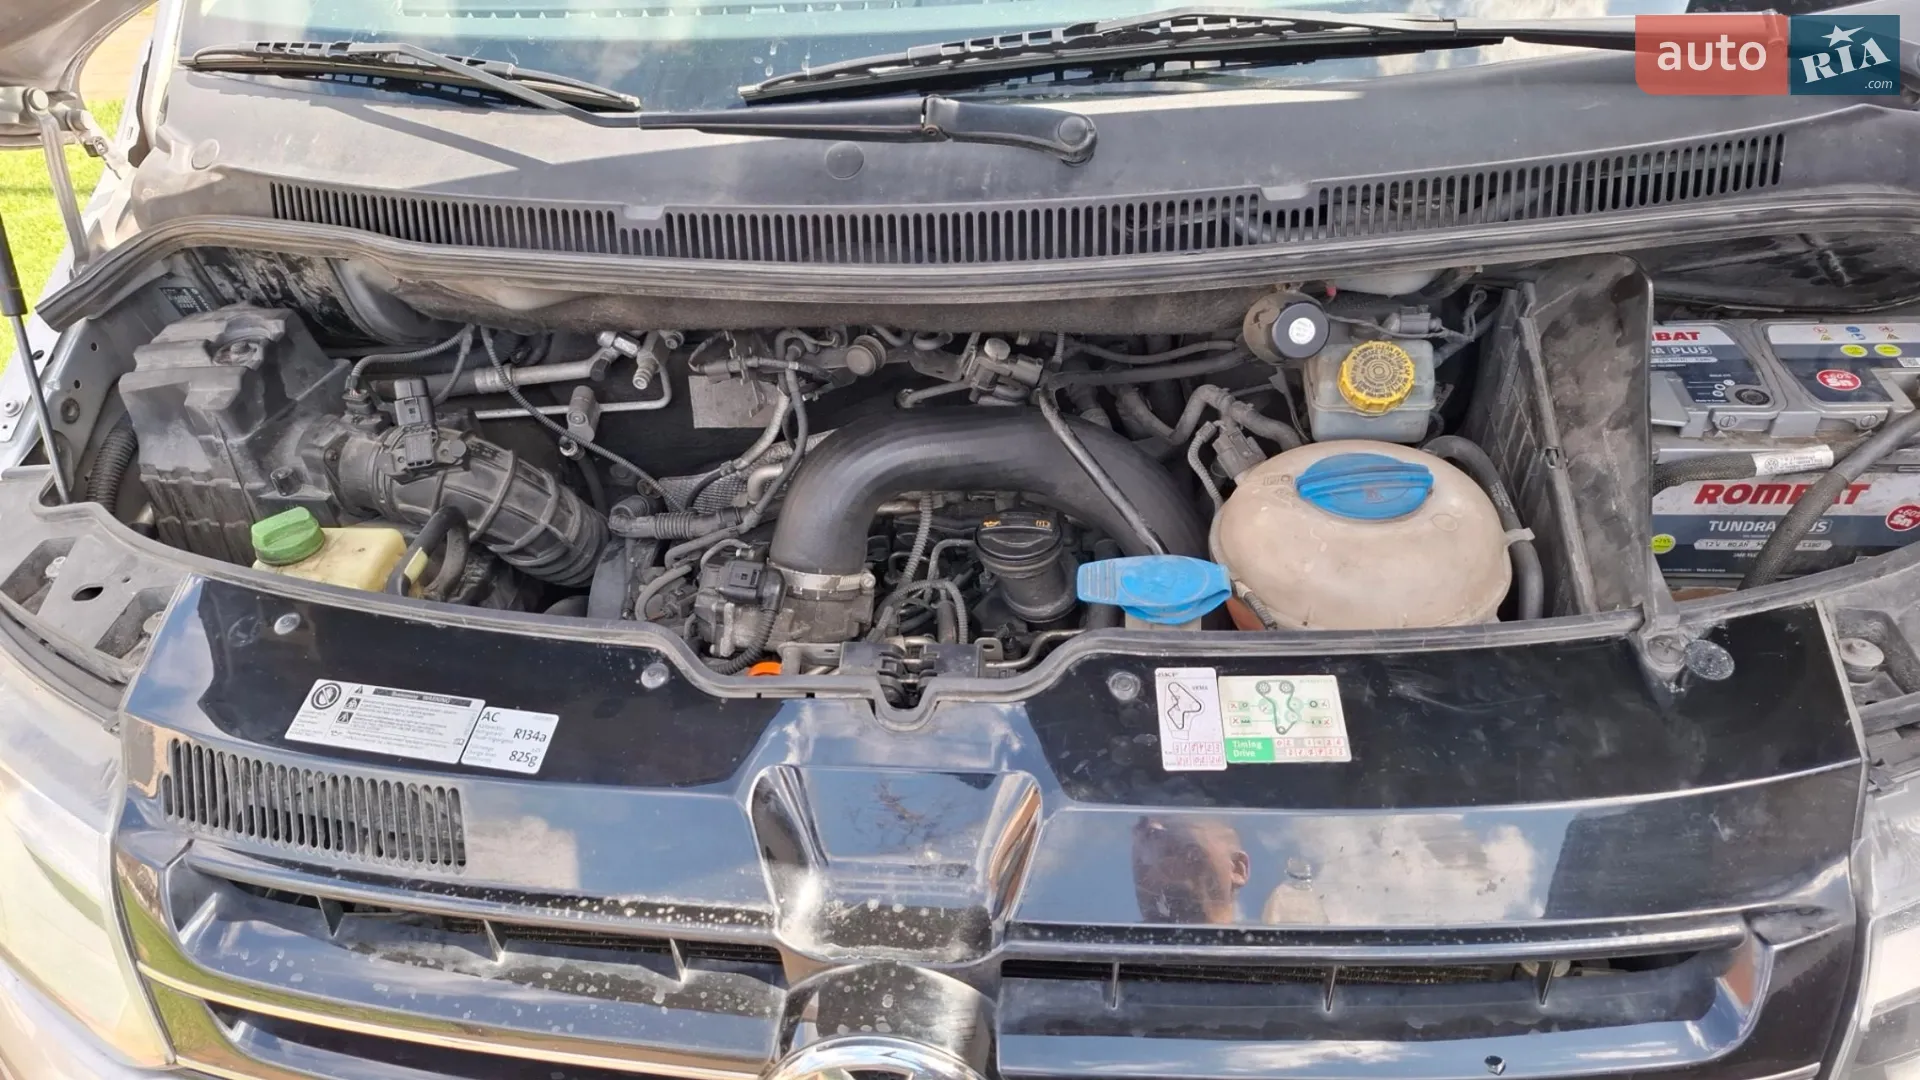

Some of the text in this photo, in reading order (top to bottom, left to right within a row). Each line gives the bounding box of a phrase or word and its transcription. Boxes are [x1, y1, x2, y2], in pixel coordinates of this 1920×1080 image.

[1651, 331, 1700, 341] BAT
[1709, 520, 1777, 532] TUNDRA
[1890, 514, 1914, 527] Sn
[481, 711, 500, 723] AC
[513, 727, 547, 743] R134a
[1232, 740, 1263, 749] Timing
[509, 750, 538, 768] 825g
[1233, 749, 1256, 757] Drive
